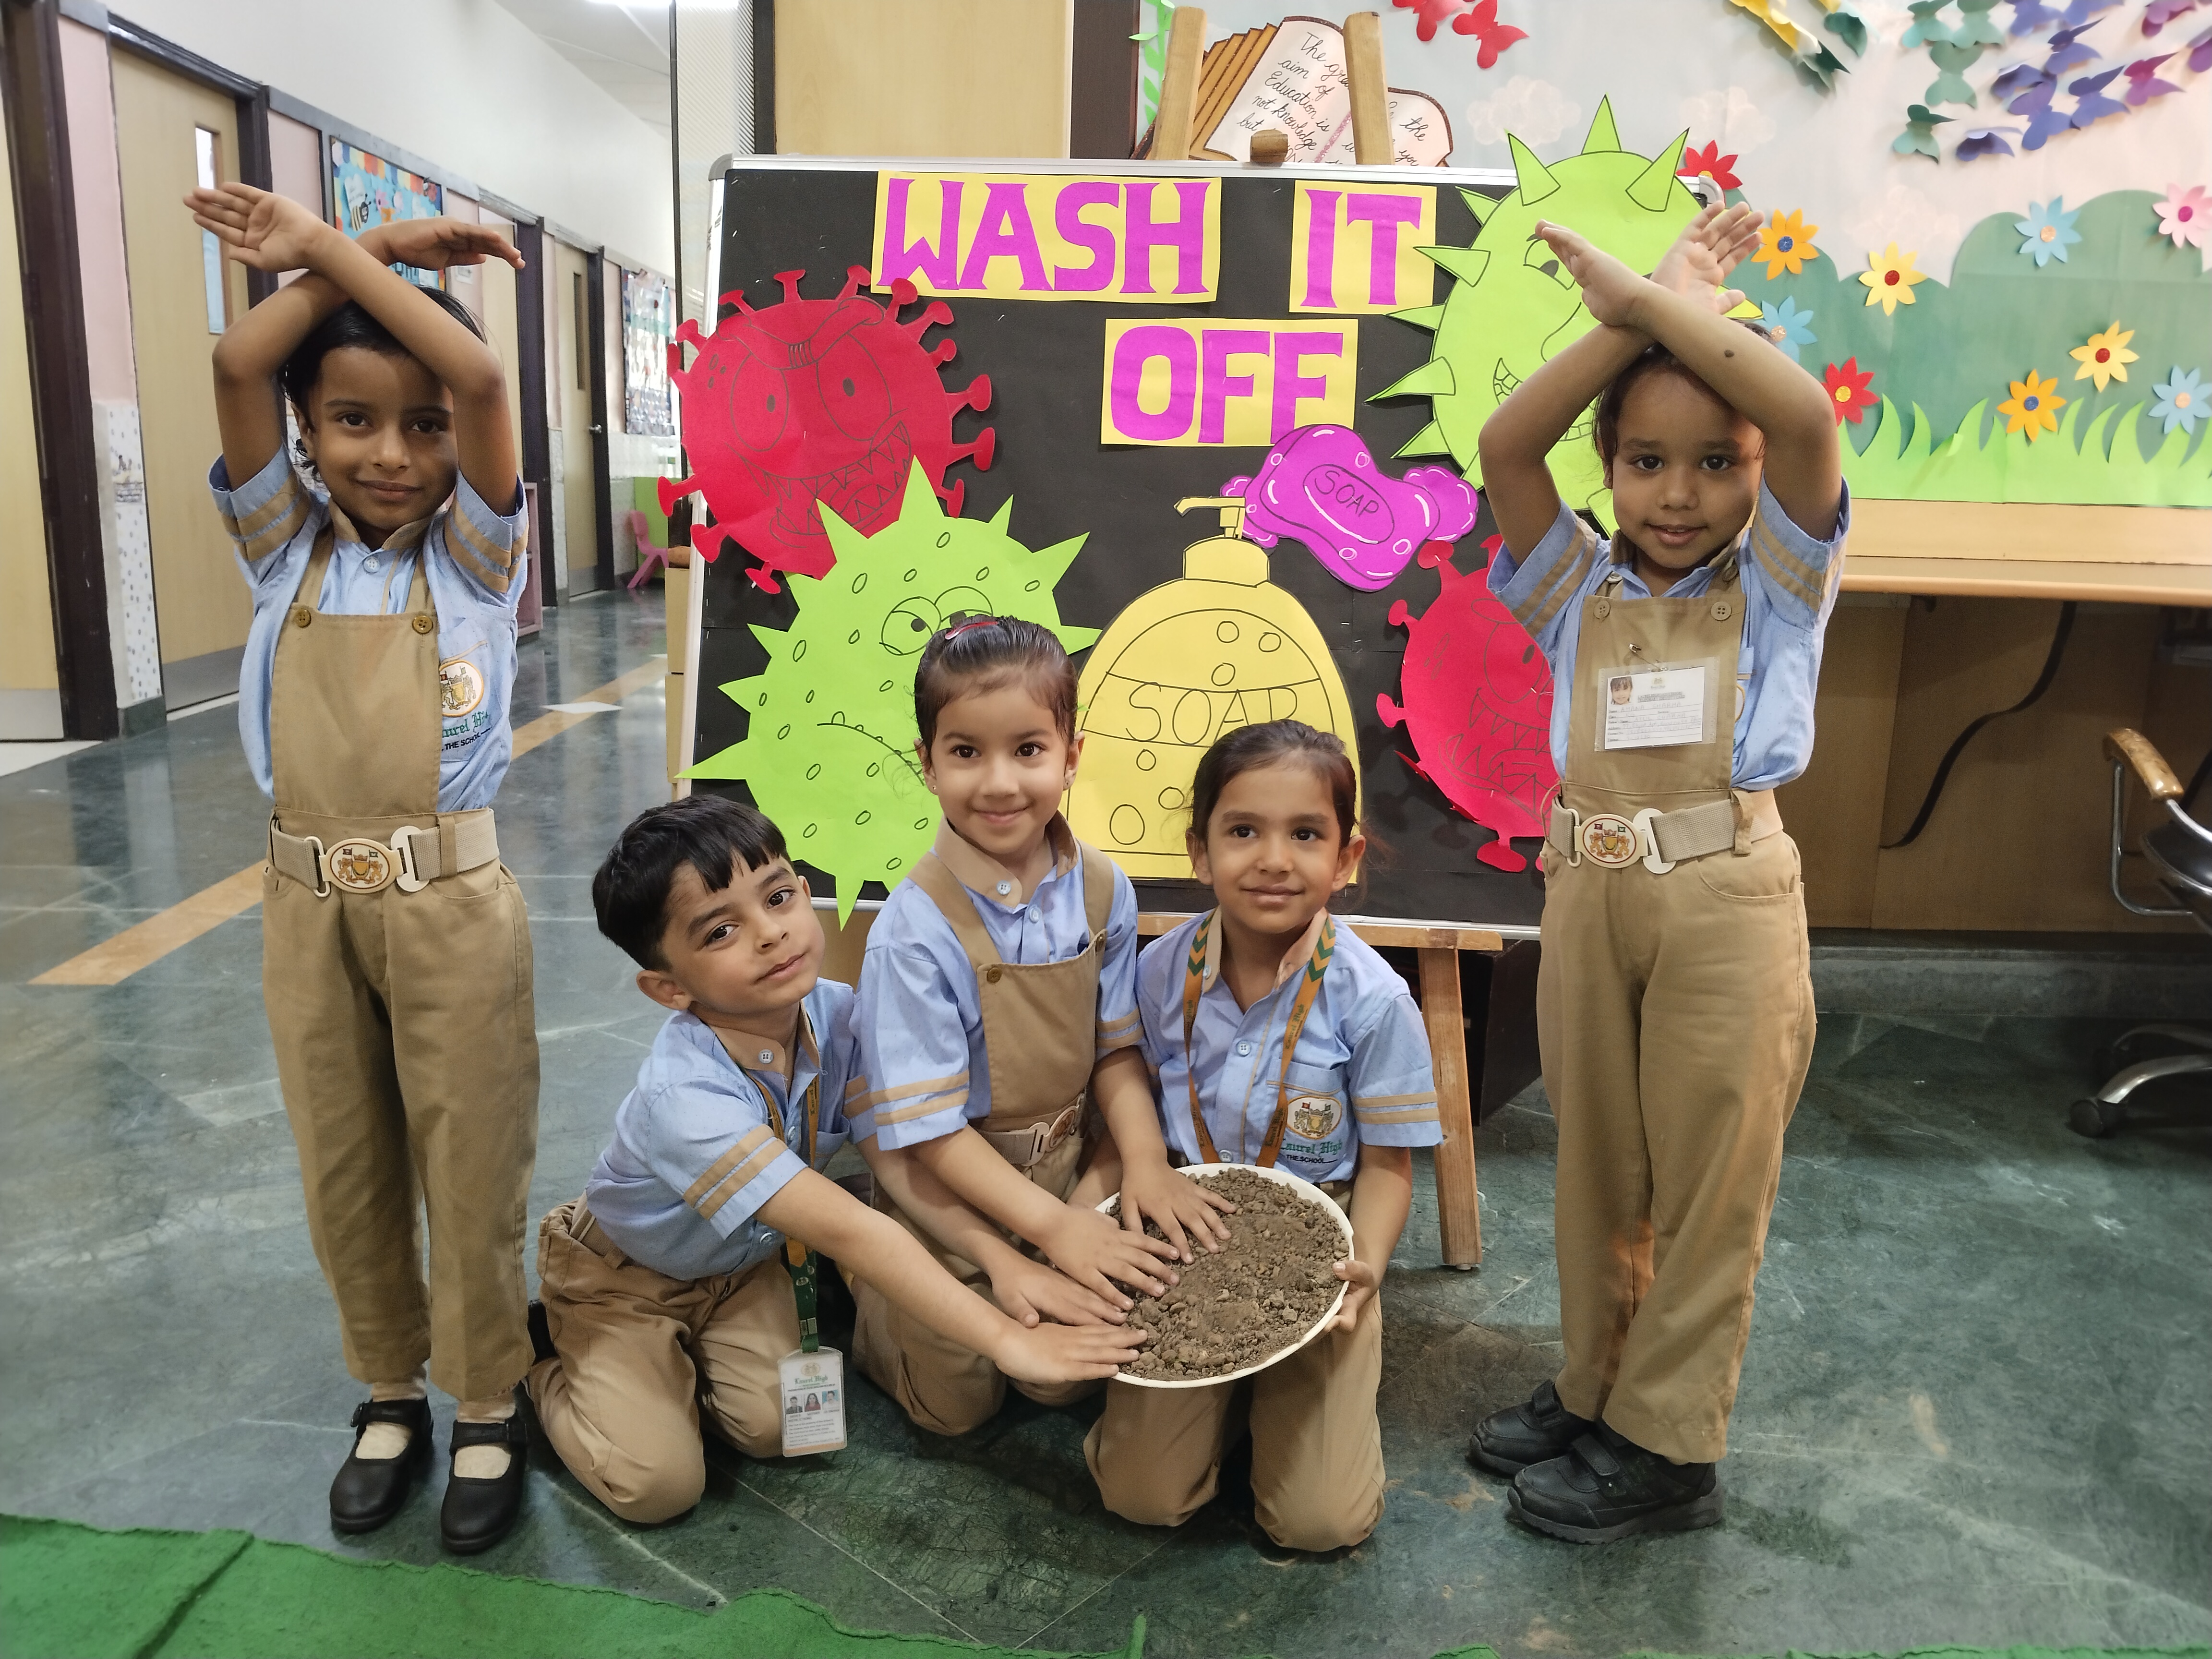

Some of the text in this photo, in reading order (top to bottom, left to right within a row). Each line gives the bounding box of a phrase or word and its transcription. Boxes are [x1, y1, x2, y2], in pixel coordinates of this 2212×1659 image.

[1278, 60, 1335, 101] aim of
[1301, 32, 1349, 87] The gre
[1237, 112, 1265, 131] but
[1252, 96, 1317, 150] not knowledge
[1264, 71, 1330, 132] Education is
[1399, 117, 1429, 141] the
[876, 177, 1422, 308] WASH IT
[1110, 325, 1344, 444] OFF
[1314, 470, 1379, 518] SOAP
[445, 741, 459, 750] THE
